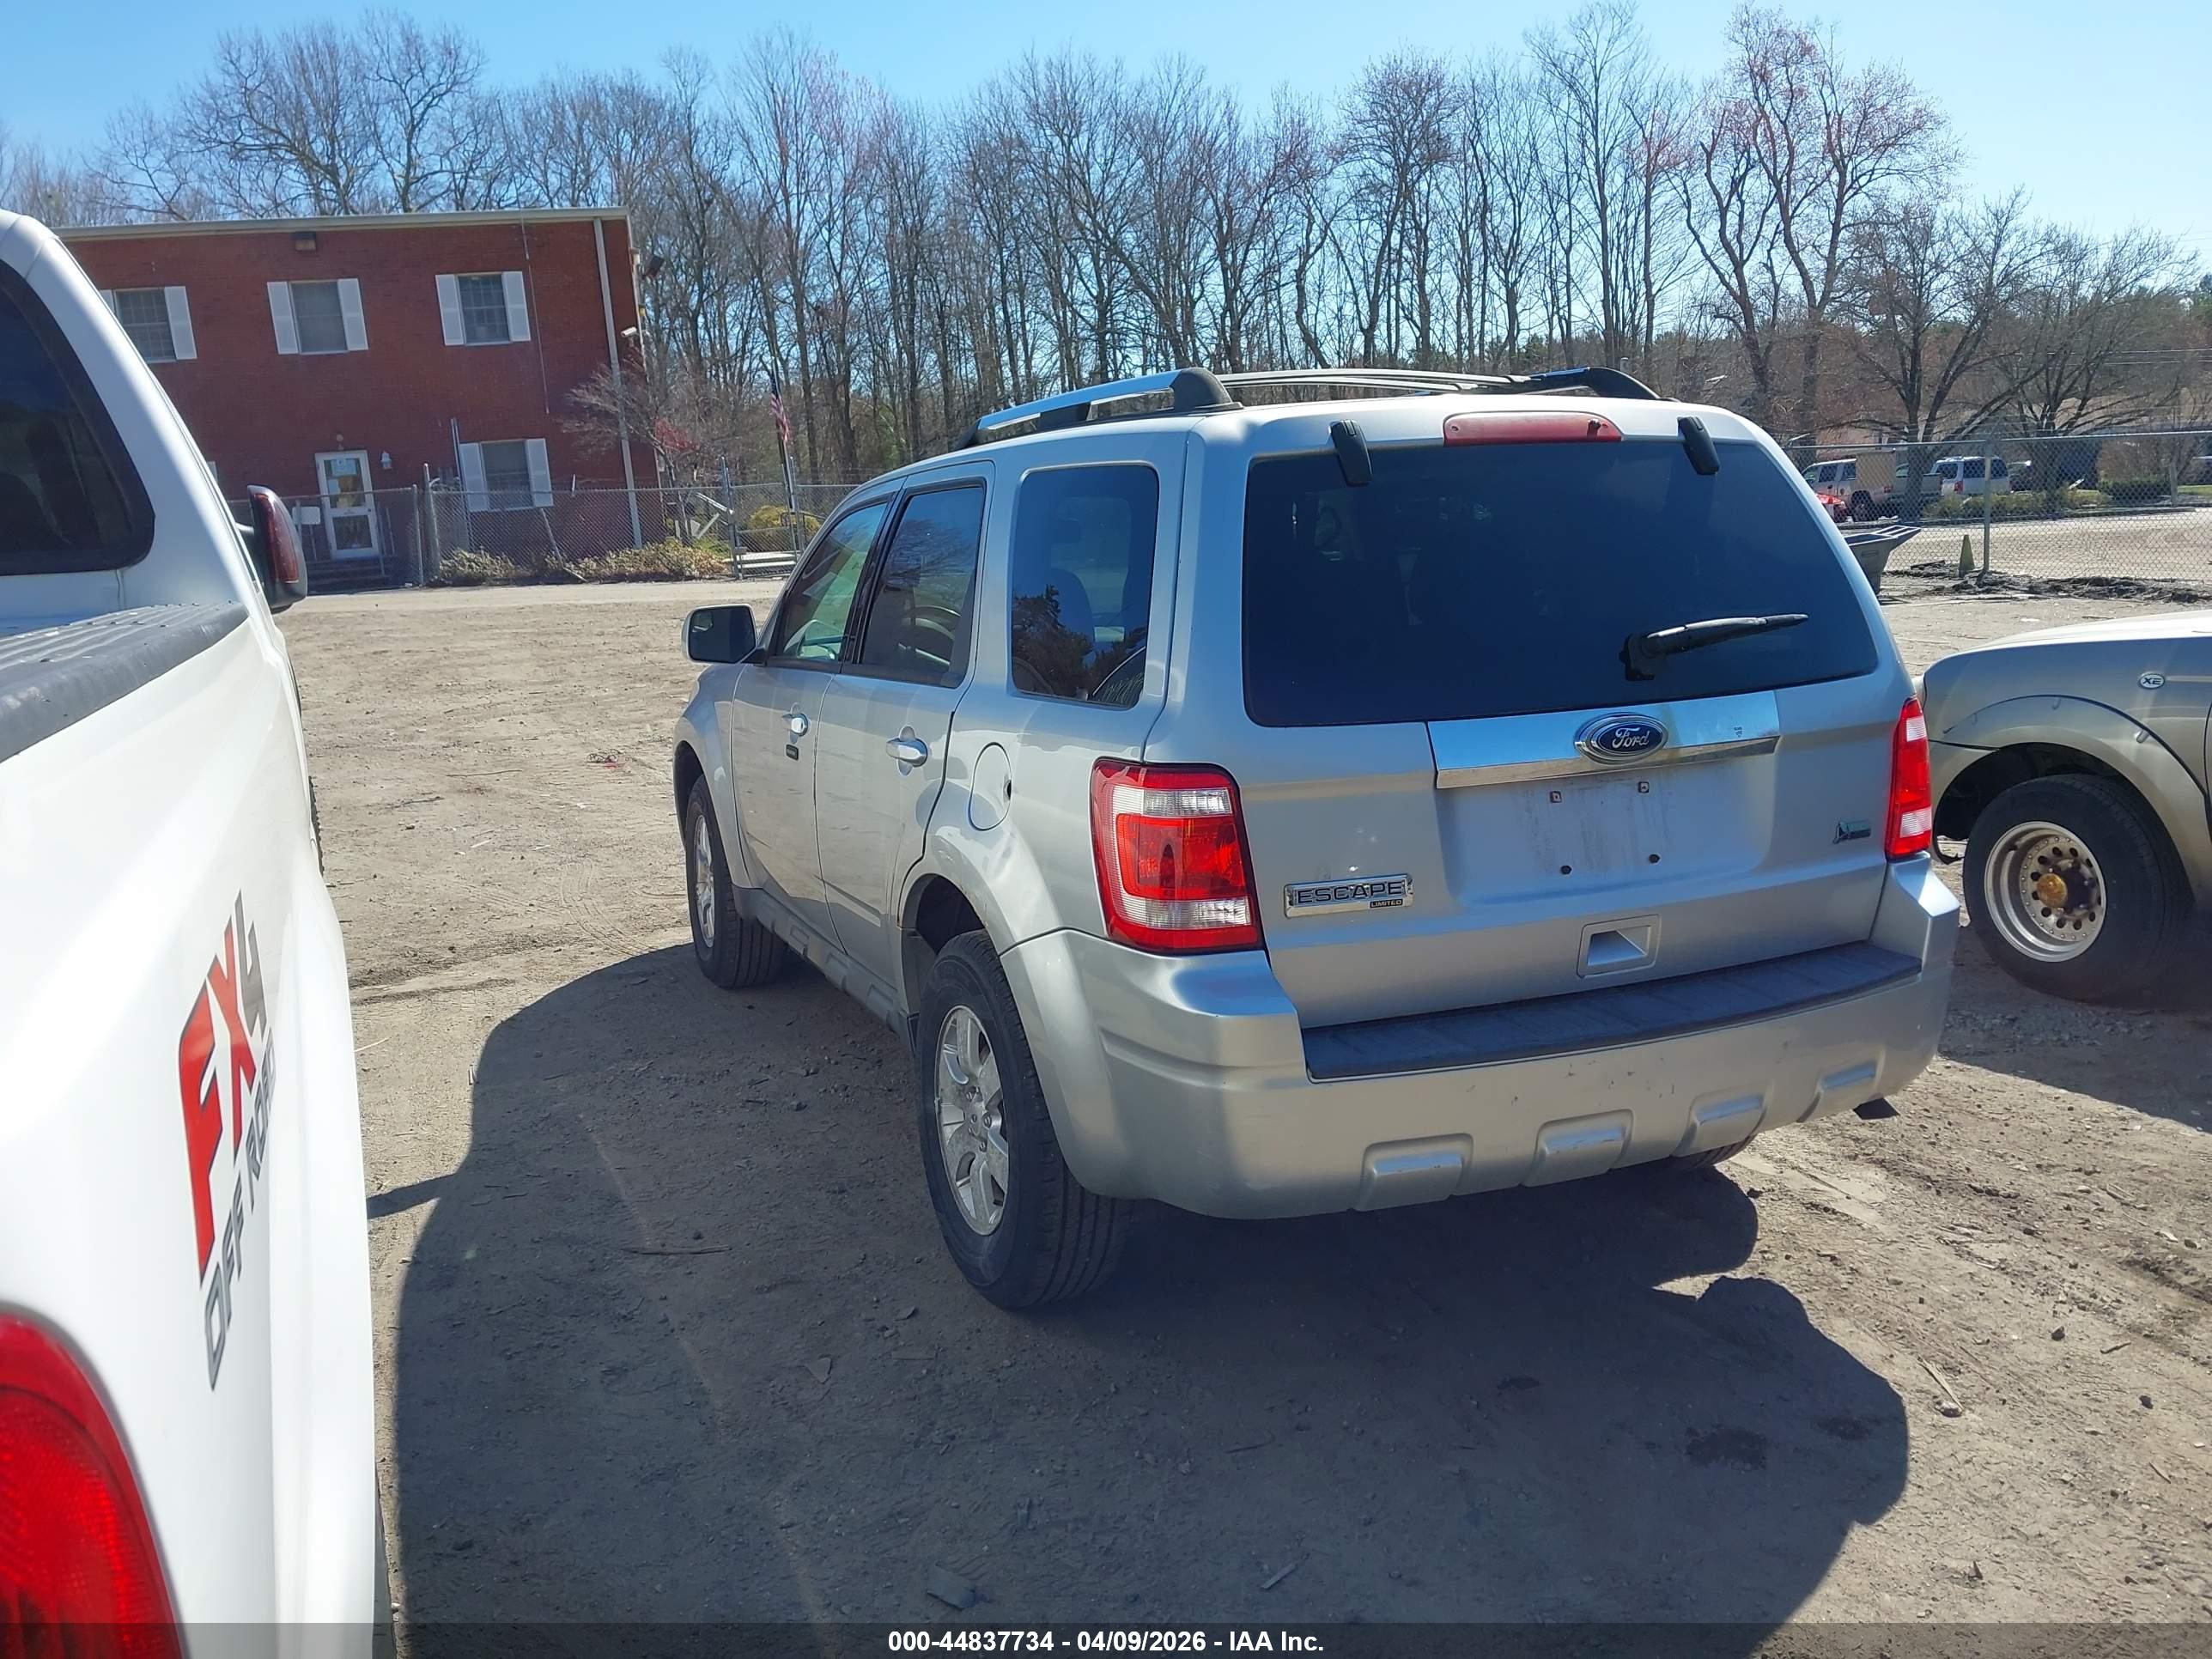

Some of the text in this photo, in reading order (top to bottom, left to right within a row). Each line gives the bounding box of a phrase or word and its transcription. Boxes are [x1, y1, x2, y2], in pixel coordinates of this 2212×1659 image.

[2142, 677, 2162, 685] XE
[1612, 726, 1650, 749] Ford
[1297, 880, 1402, 904] ESCAPE
[1370, 899, 1402, 908] LIMITED
[178, 888, 267, 1291] FX4
[204, 1026, 276, 1392] OFF ROAD
